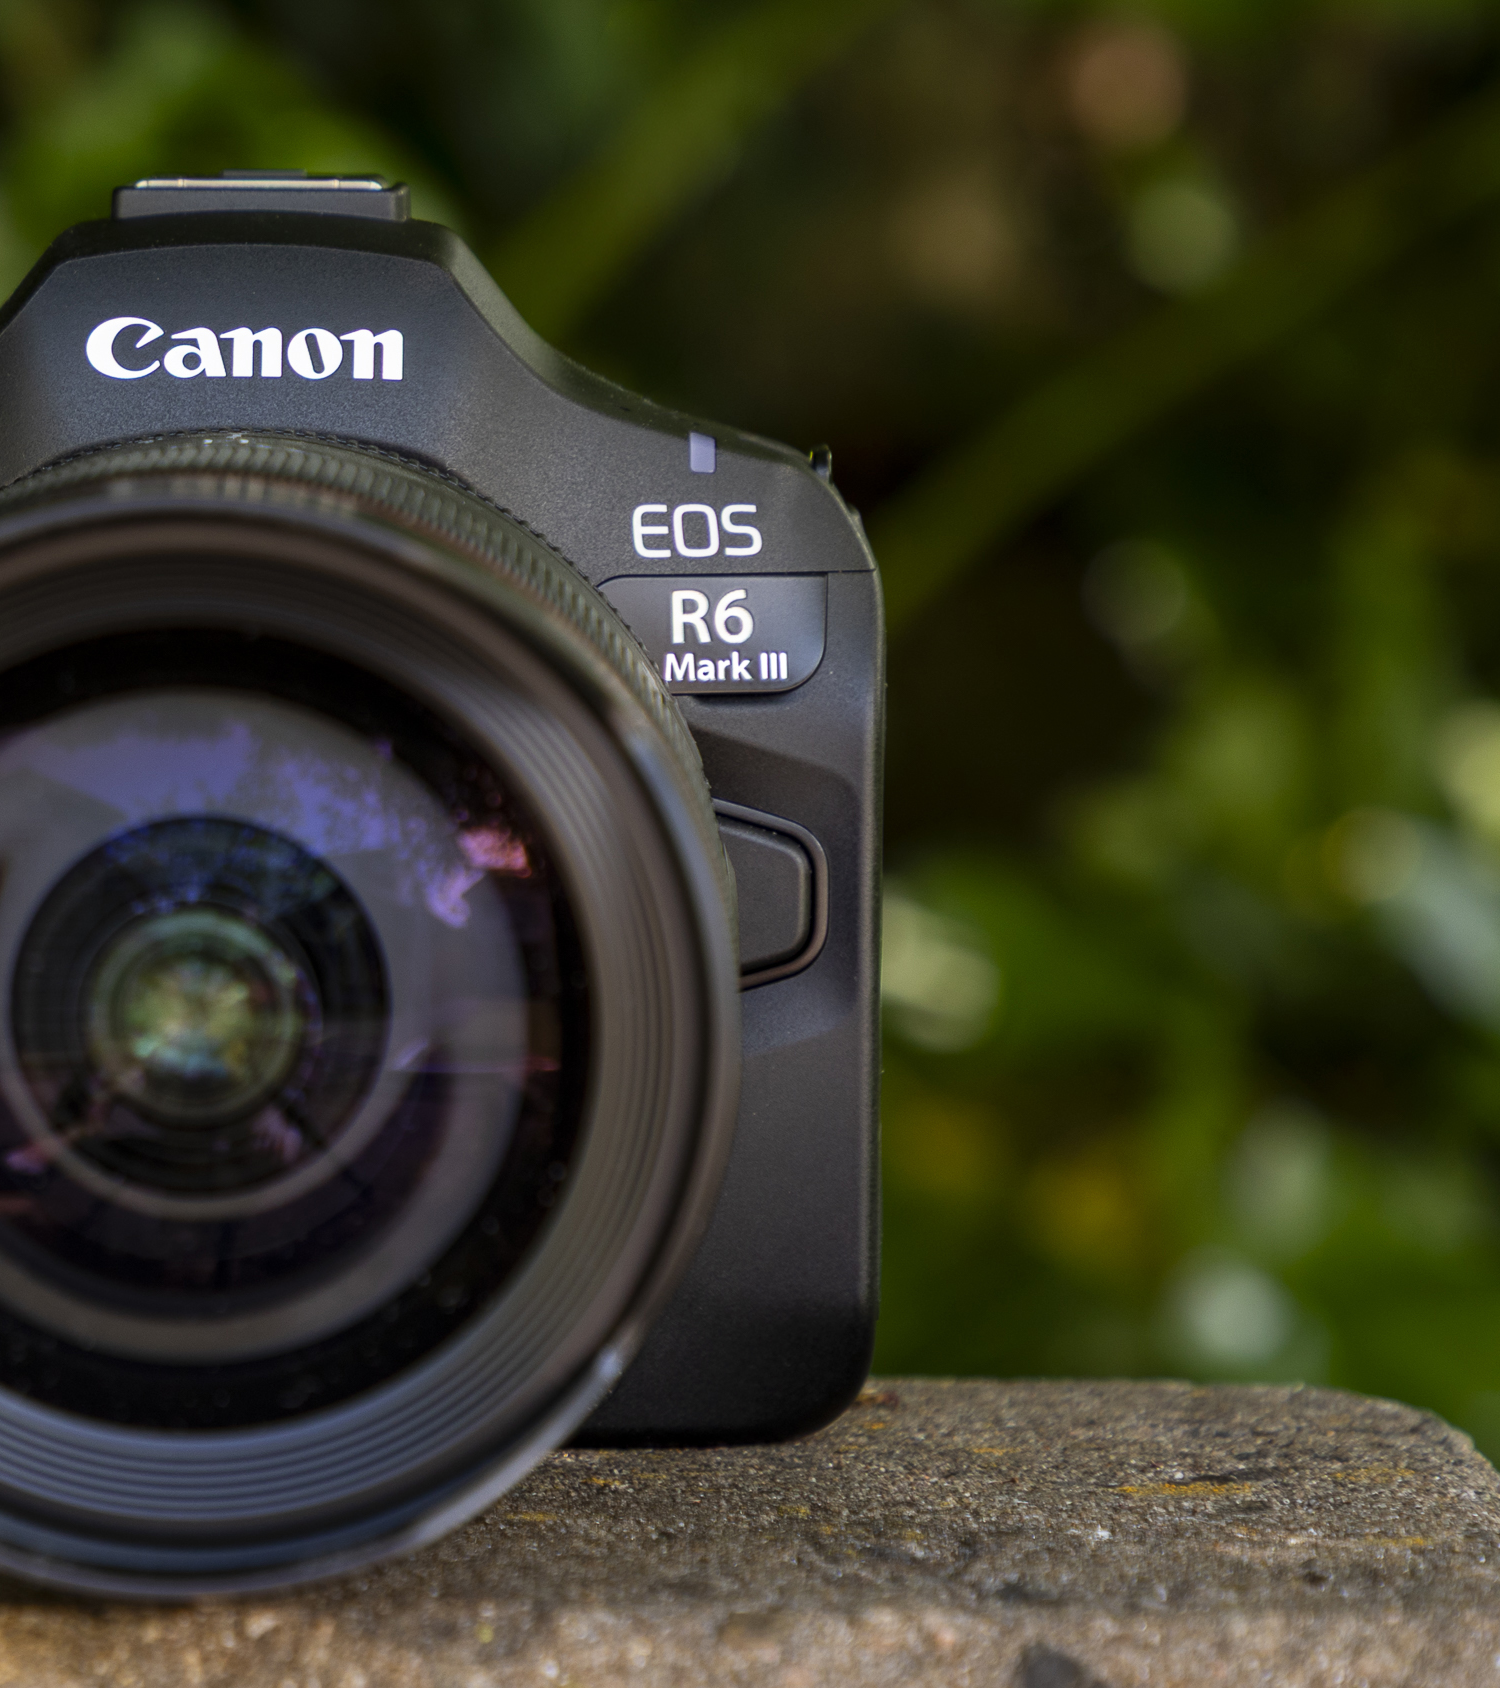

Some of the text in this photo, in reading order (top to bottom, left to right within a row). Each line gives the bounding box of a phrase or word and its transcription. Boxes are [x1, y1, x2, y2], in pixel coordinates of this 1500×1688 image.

[85, 316, 404, 381] Canon
[631, 503, 763, 558] EOS
[670, 588, 754, 644] R6
[664, 650, 788, 682] Mark III
